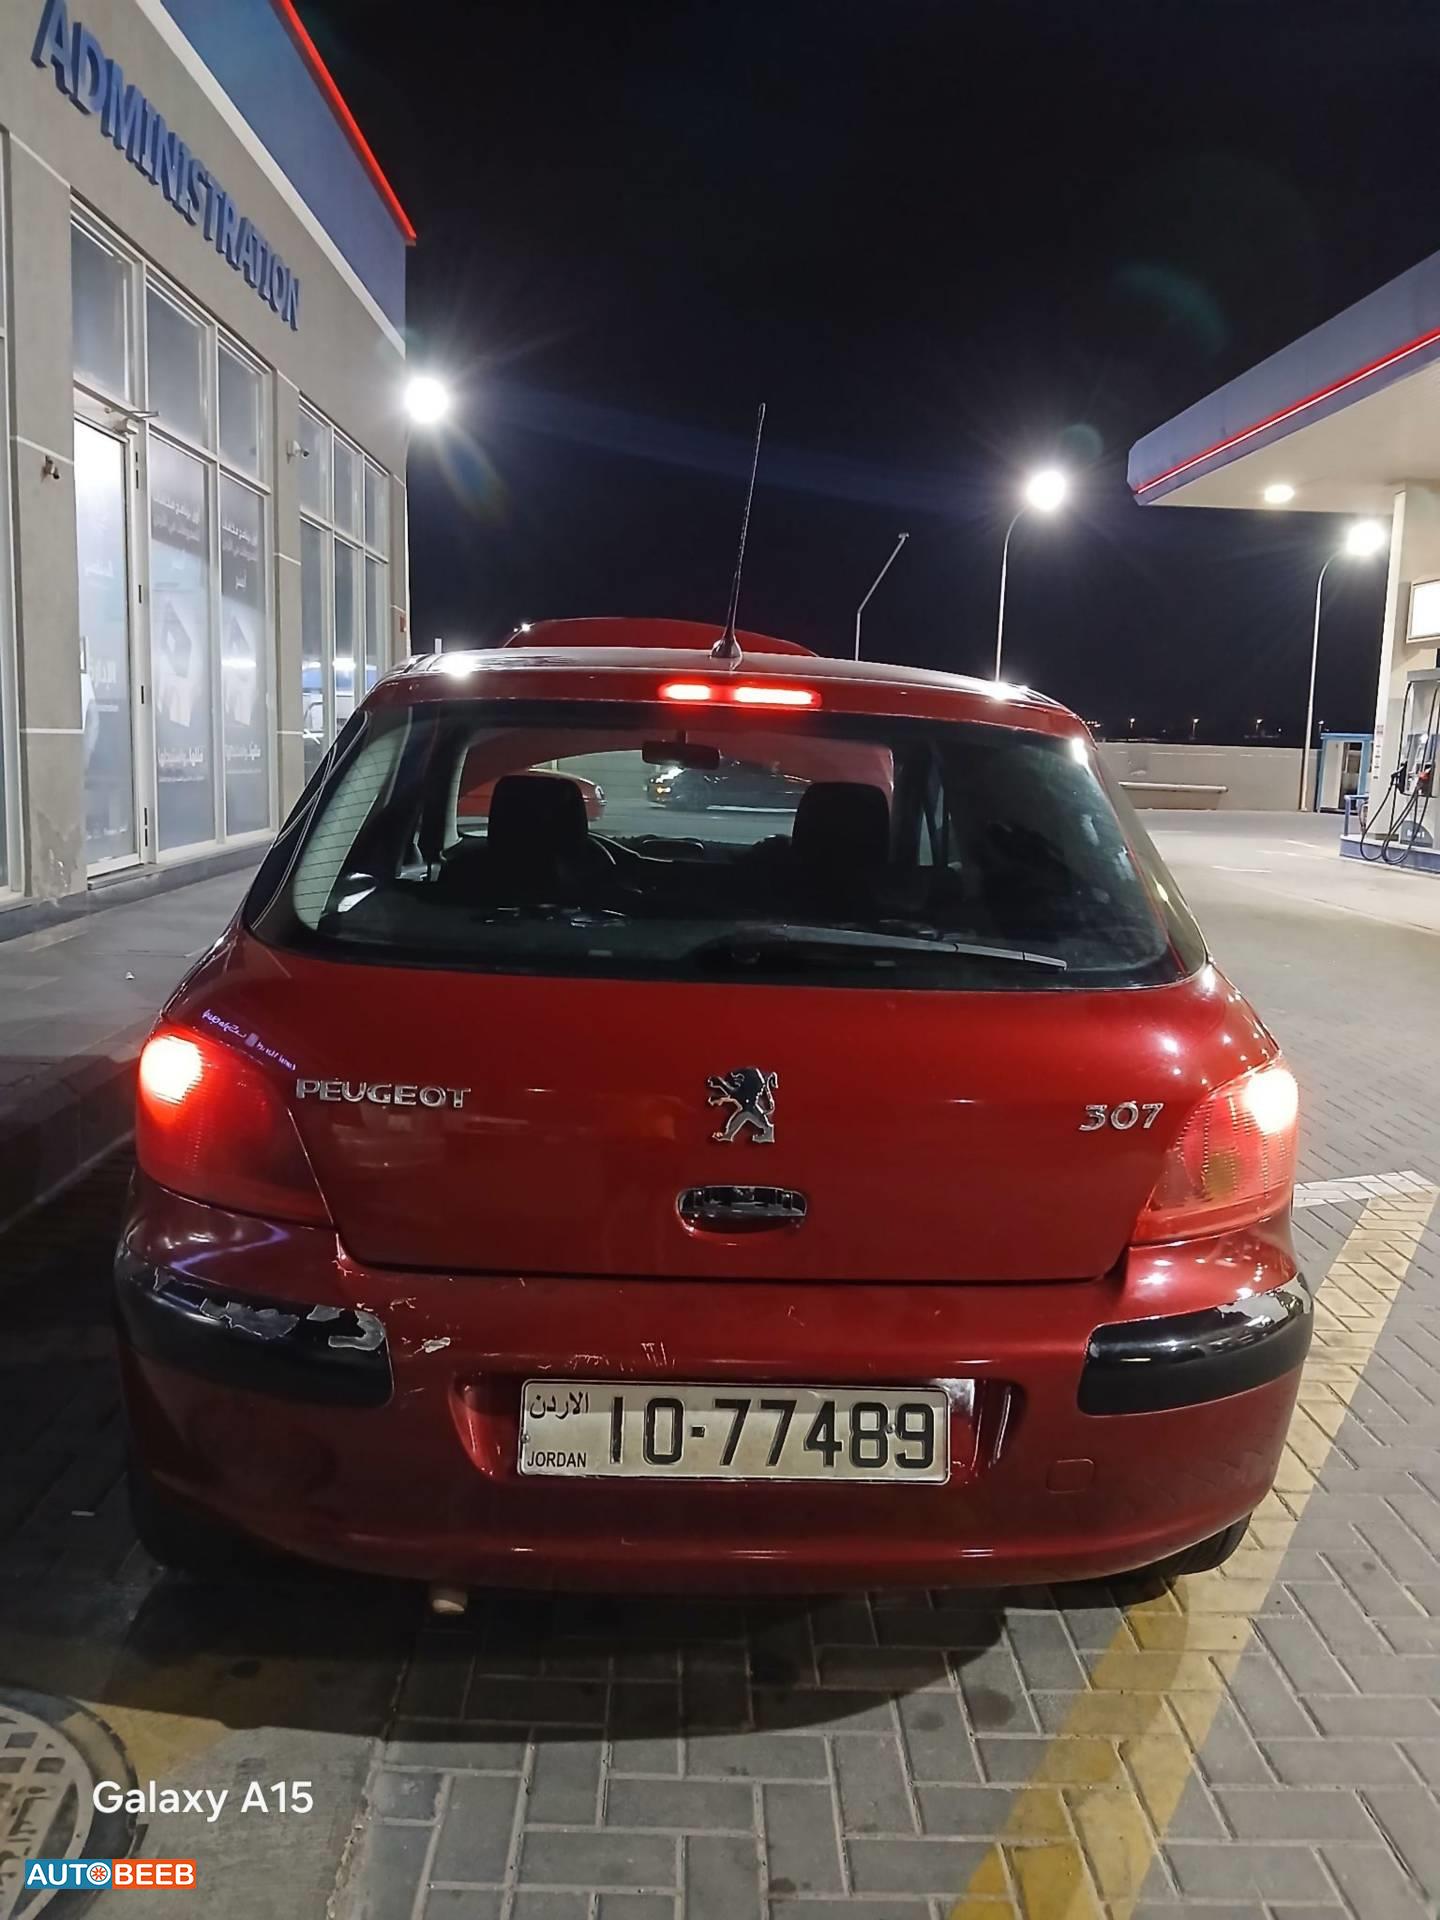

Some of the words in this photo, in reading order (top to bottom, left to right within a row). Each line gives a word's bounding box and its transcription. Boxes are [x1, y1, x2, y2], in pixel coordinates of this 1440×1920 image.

[31, 0, 300, 331] ADMINISTRATION
[296, 1077, 472, 1109] PEUGEOT
[1078, 1100, 1164, 1131] 307
[527, 1451, 587, 1468] JORDAN
